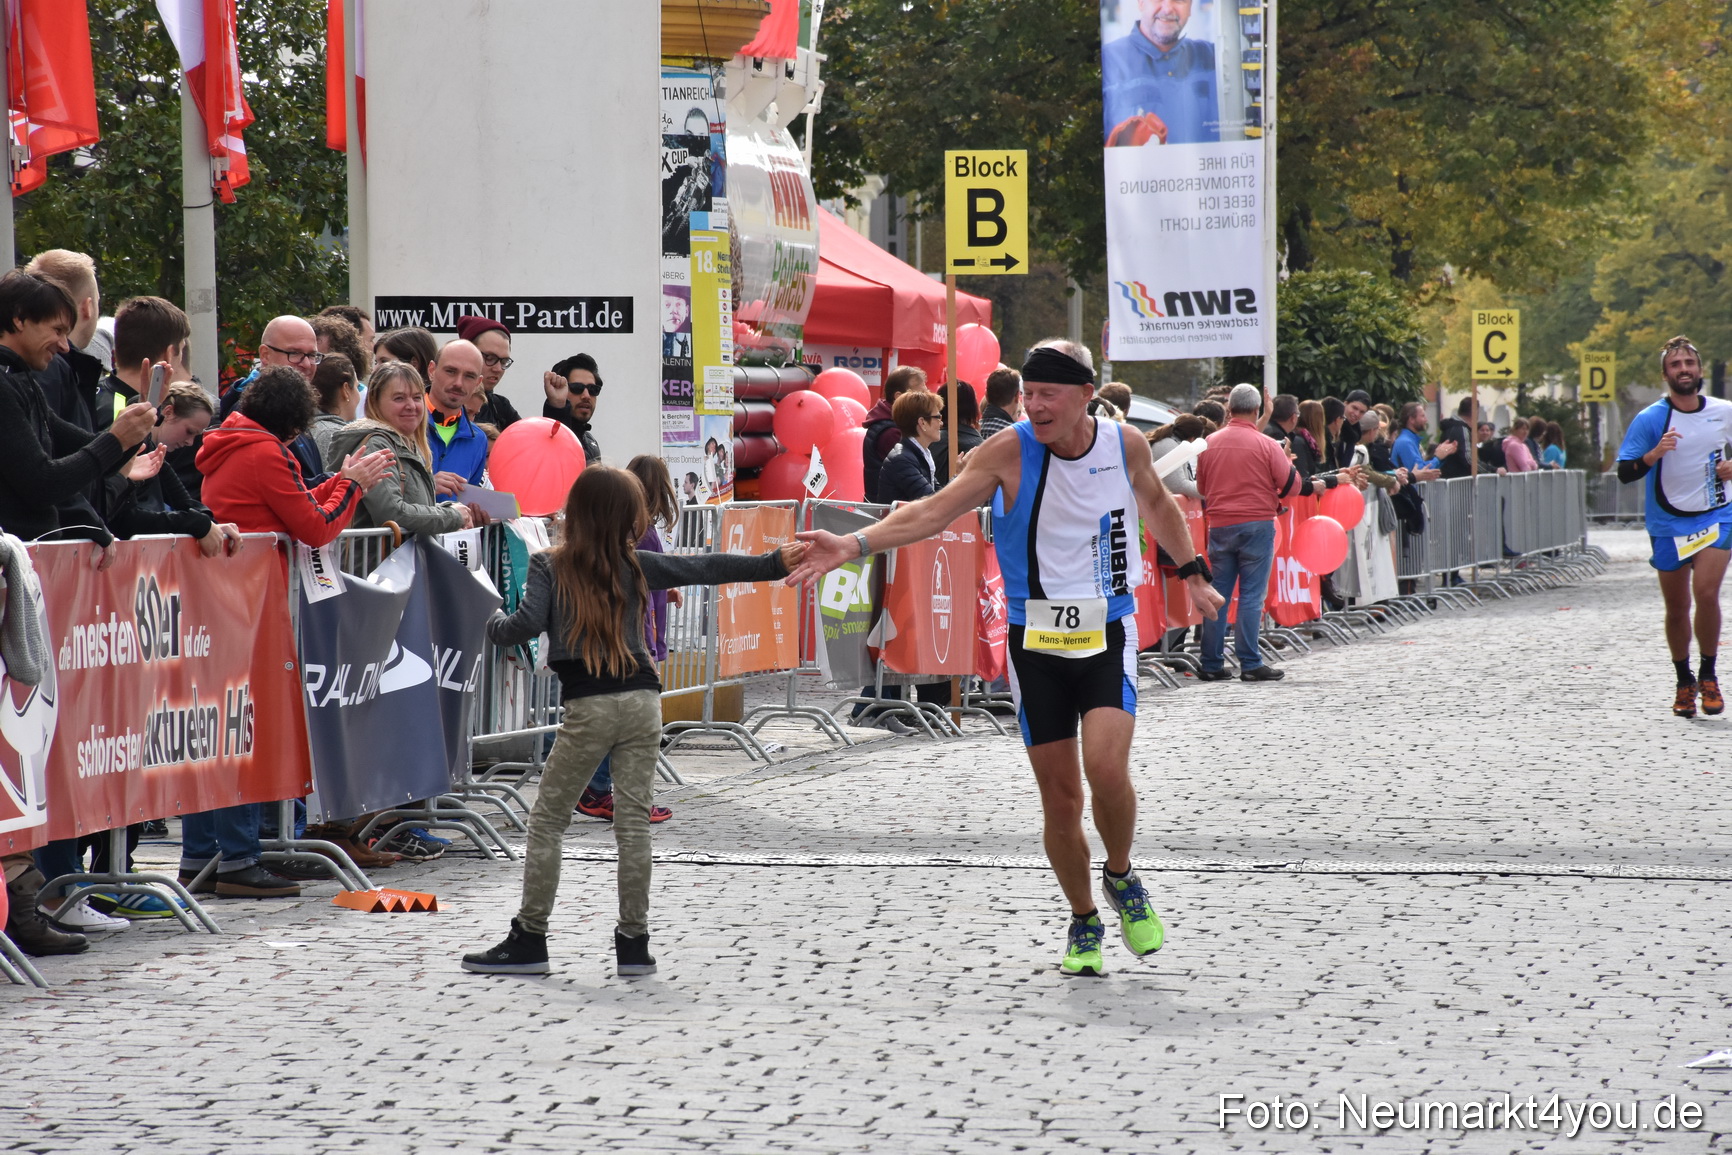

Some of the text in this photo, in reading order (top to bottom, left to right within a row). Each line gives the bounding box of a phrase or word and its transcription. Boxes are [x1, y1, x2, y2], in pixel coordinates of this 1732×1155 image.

[662, 86, 710, 101] TIANREICH
[671, 150, 688, 165] CUP
[955, 155, 1018, 177] Block
[967, 188, 1008, 247] B
[694, 250, 717, 273] 18.
[1478, 313, 1514, 325] Block
[1483, 330, 1507, 364] C
[1584, 354, 1611, 363] Block
[662, 379, 694, 397] KER
[1590, 367, 1607, 390] D
[73, 605, 137, 670] meisten
[135, 575, 182, 664] 80er
[193, 625, 211, 658] die
[1051, 606, 1080, 629] 78
[1038, 634, 1092, 646] Hans-Werner
